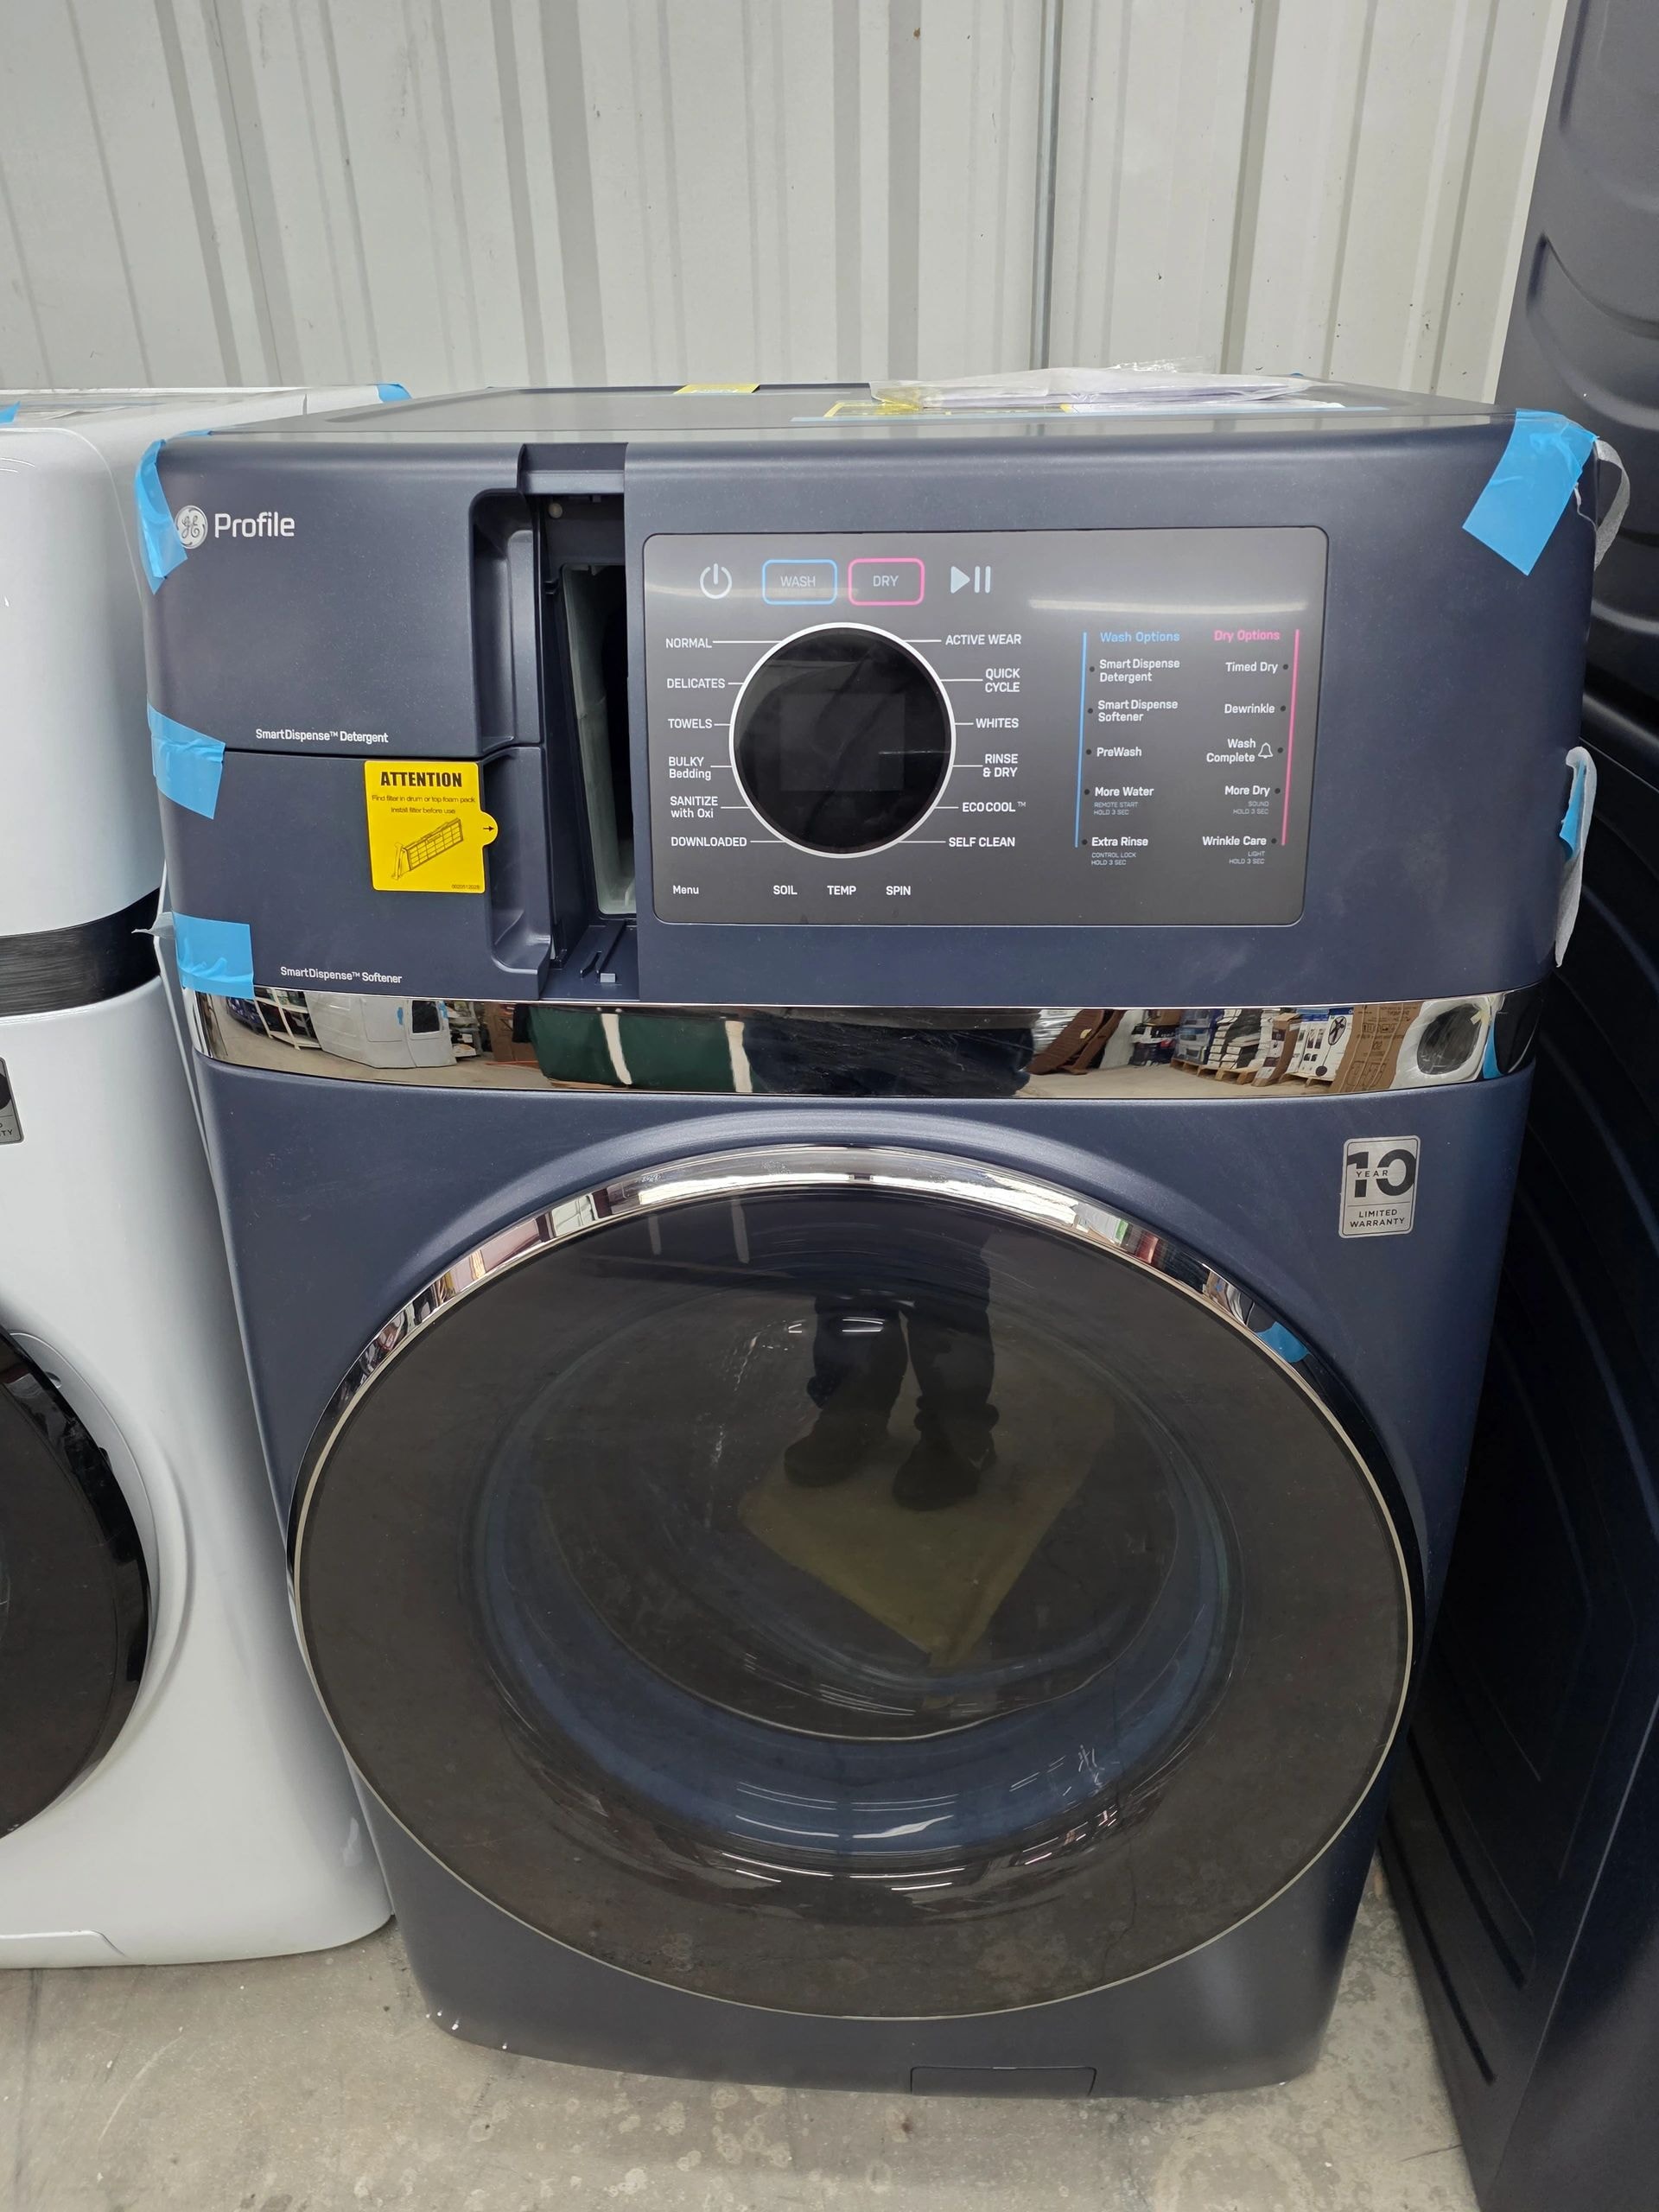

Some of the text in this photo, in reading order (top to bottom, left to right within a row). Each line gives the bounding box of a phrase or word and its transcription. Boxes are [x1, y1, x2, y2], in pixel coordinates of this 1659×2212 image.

[214, 512, 296, 538] Profile
[780, 575, 816, 588] WASH
[873, 575, 899, 587] DRY
[945, 633, 1021, 645] ACTIVE WEAR
[1100, 632, 1180, 645] Wash Options
[1214, 629, 1281, 643] Dry Options
[665, 638, 712, 648] NORMAL
[1225, 661, 1279, 674] Timed Dry
[985, 668, 1020, 680] QUICK
[1099, 671, 1153, 683] Detergent
[666, 677, 726, 689] DELICATES
[985, 682, 1020, 692] CYCLE
[1224, 703, 1275, 714] Dewrinkle
[1097, 711, 1144, 722] Softener
[668, 718, 713, 728] TOWELS
[976, 718, 1020, 728] WHITES
[340, 731, 389, 745] Detergent
[1227, 738, 1256, 748] Wash
[1096, 747, 1142, 757] PreWash
[668, 756, 704, 766] BULKY
[985, 753, 1019, 764] RINSE
[1206, 753, 1255, 764] Complete
[669, 768, 712, 781] Bedding
[982, 767, 1018, 778] & DRY
[381, 772, 462, 788] ATTENTION
[1094, 785, 1154, 797] More Water
[1224, 785, 1271, 798] More Dry
[670, 796, 719, 806] SANITIZE
[671, 807, 714, 818] with Oxi
[671, 836, 747, 847] DOWNLOADED
[949, 836, 1015, 847] SELF CLEAN
[1091, 836, 1149, 847] Extra Rinse
[1202, 836, 1268, 846] Wrinkle Care
[672, 885, 699, 894] Menu
[772, 885, 798, 895] SOIL
[827, 885, 857, 895] TEMP
[886, 886, 912, 896] SPIN
[361, 972, 403, 983] Softener
[1347, 1148, 1417, 1198] 10
[1356, 1169, 1389, 1178] YEAR
[1358, 1209, 1398, 1218] LIMITED
[1350, 1217, 1405, 1228] WARRANTY
